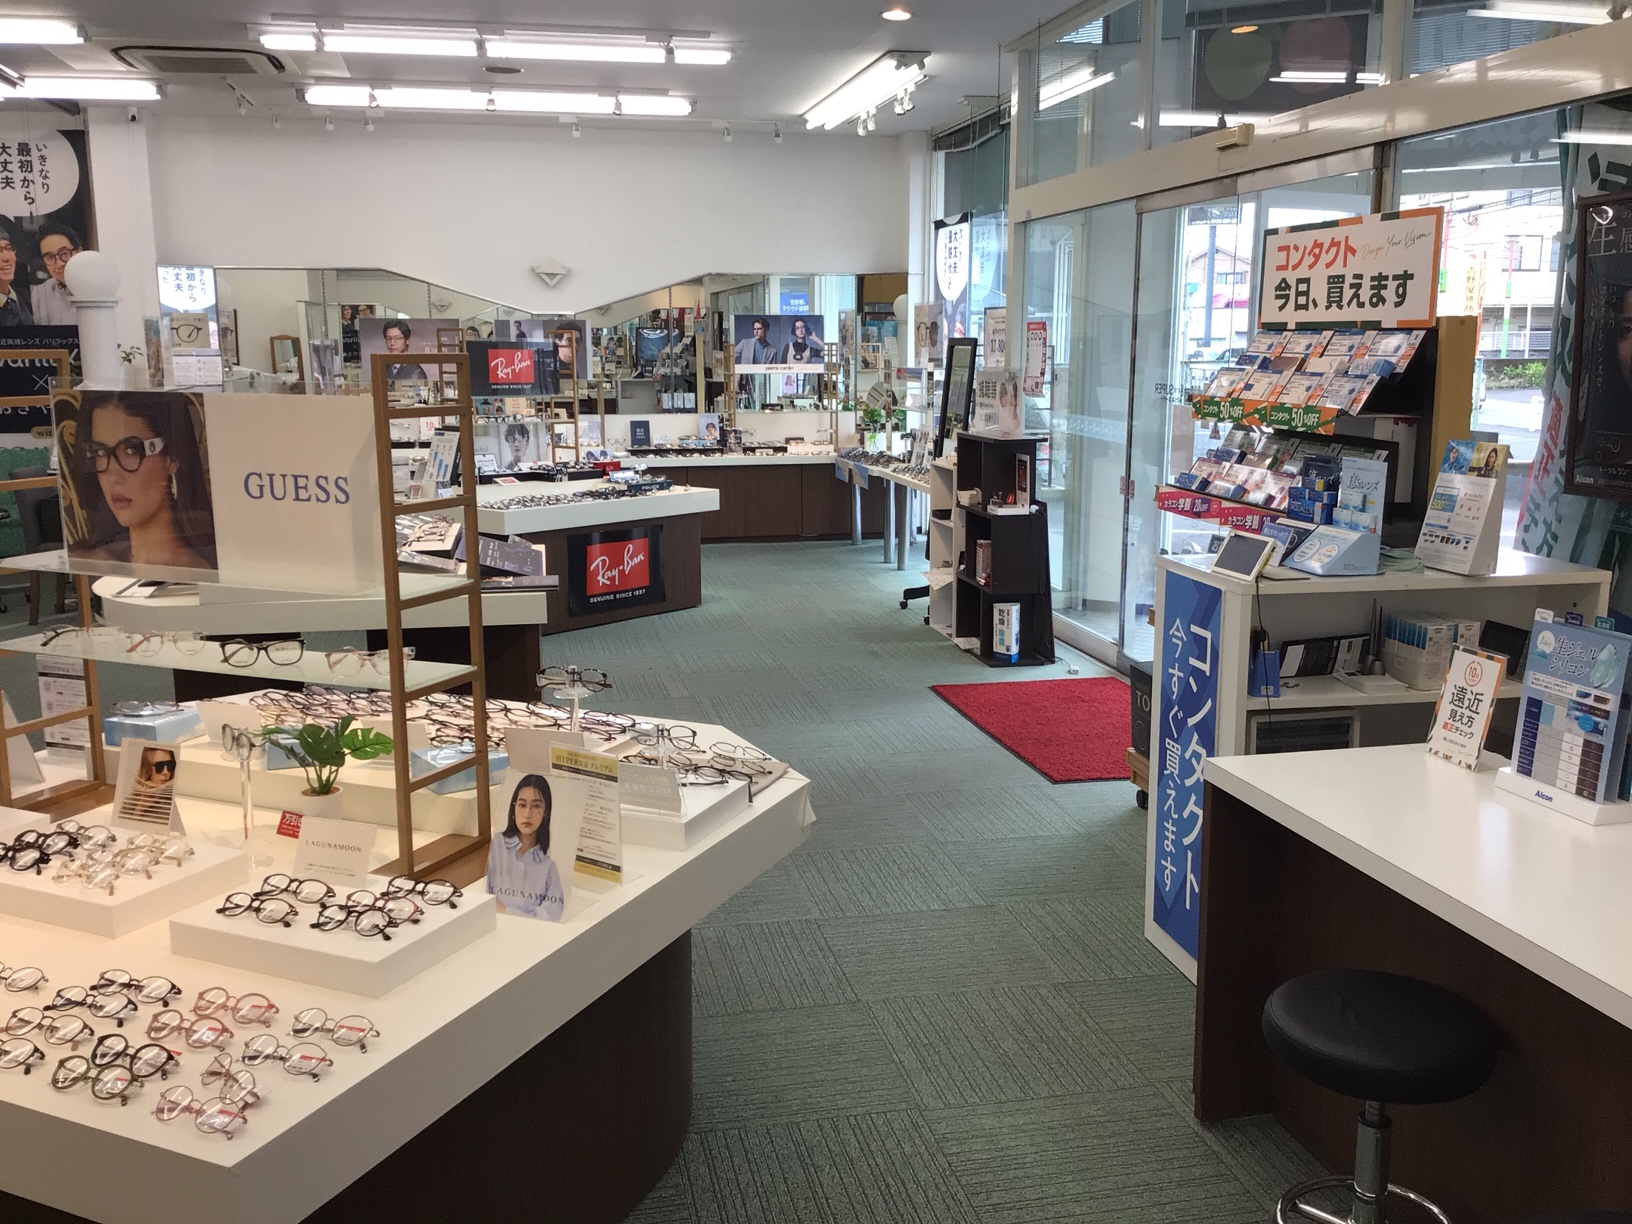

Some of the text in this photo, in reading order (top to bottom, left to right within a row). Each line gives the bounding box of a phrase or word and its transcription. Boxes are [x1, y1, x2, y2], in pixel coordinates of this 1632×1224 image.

[0, 142, 15, 190] 大丈夫
[16, 142, 35, 206] 最初から
[36, 143, 50, 194] いきなり
[1404, 229, 1432, 250] Vision
[1275, 235, 1357, 272] コンタクト
[1274, 269, 1415, 313] 今日、買えます
[1203, 405, 1219, 414] コンタクト
[1270, 411, 1290, 421] コンタクト
[243, 471, 351, 505] GUESS
[1575, 474, 1594, 484] Alcon
[589, 594, 614, 603] GENUINE
[1553, 637, 1601, 661] 生ジェル
[1549, 657, 1591, 678] シリコン
[1448, 684, 1485, 716] 遠近
[1447, 708, 1476, 729] 見え方
[1441, 721, 1475, 740] 適正チェック
[1160, 617, 1188, 892] 今すぐ買えます
[1182, 623, 1212, 910] コンタクト
[1534, 790, 1554, 803] Alcon
[305, 839, 362, 853] LAGUNAMOON
[490, 885, 565, 905] LAGUNAMOON
